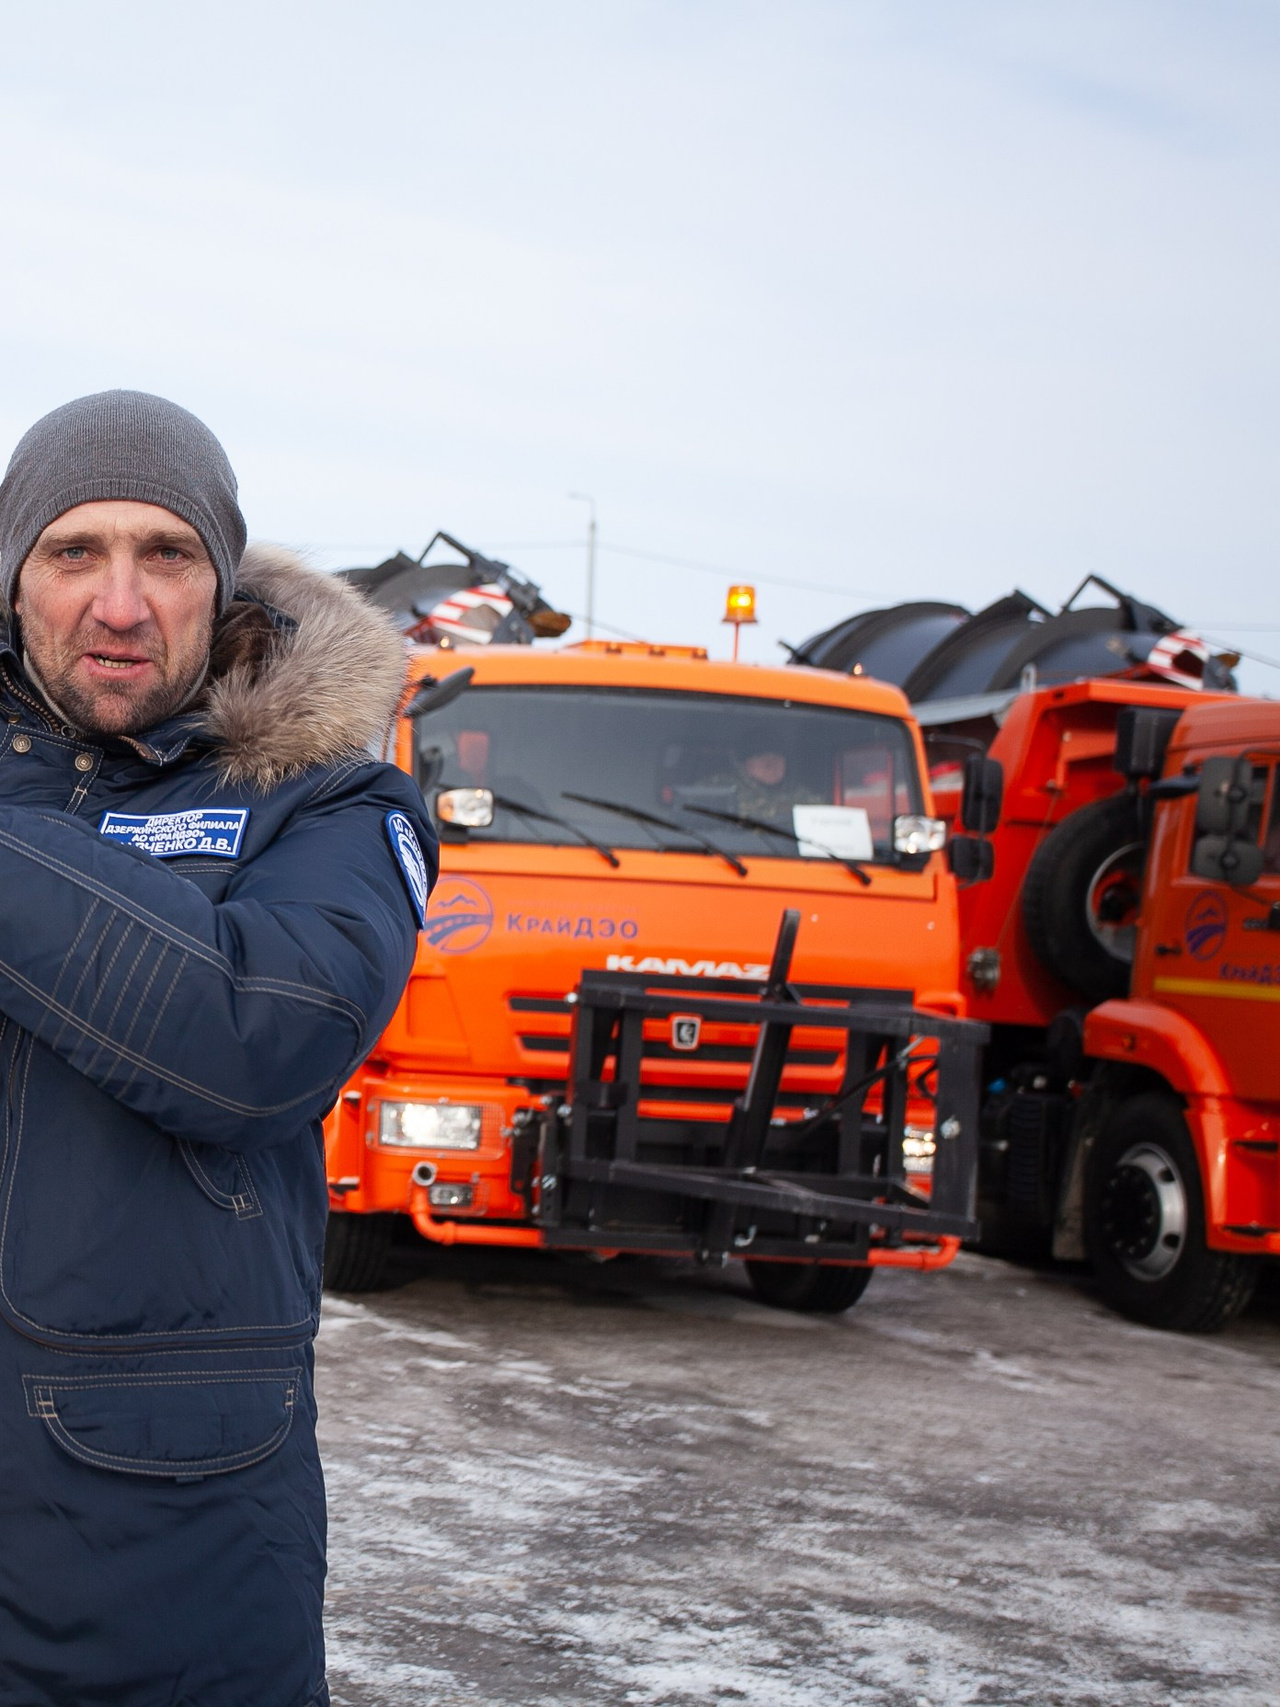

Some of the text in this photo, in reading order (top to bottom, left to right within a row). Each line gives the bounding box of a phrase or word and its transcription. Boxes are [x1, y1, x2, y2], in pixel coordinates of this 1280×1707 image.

[105, 820, 239, 834] ДЗЕРЖИНСКОГО ФИЛИАЛА
[145, 812, 203, 829] ДИРЕКТОР
[131, 833, 148, 842] АО
[198, 837, 232, 851] Д.В.
[606, 954, 771, 981] KAMAZ
